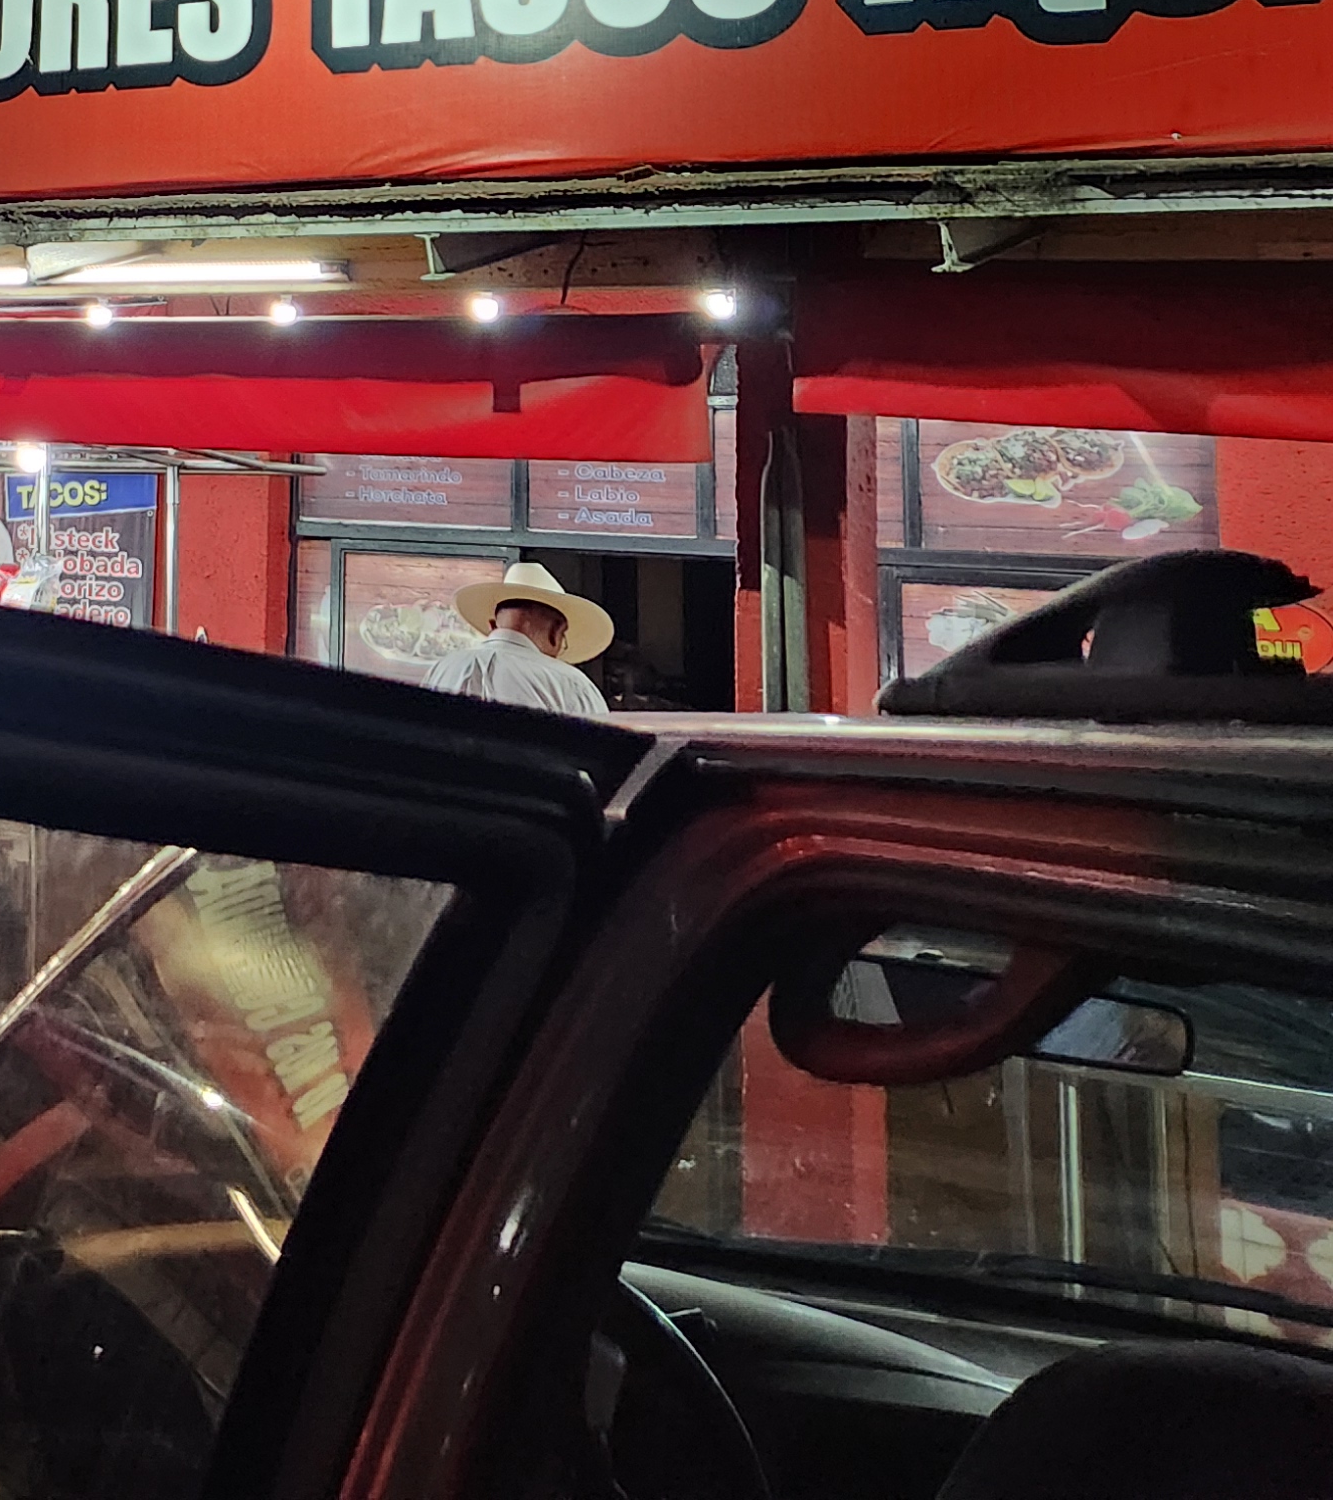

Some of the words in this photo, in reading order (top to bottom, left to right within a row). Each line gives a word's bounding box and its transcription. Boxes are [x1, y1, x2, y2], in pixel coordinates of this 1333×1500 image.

[359, 464, 463, 485] Tamarindo
[574, 463, 667, 483] Cabeza
[359, 486, 447, 507] Horchata
[574, 485, 640, 503] Labio
[574, 508, 654, 527] Asada
